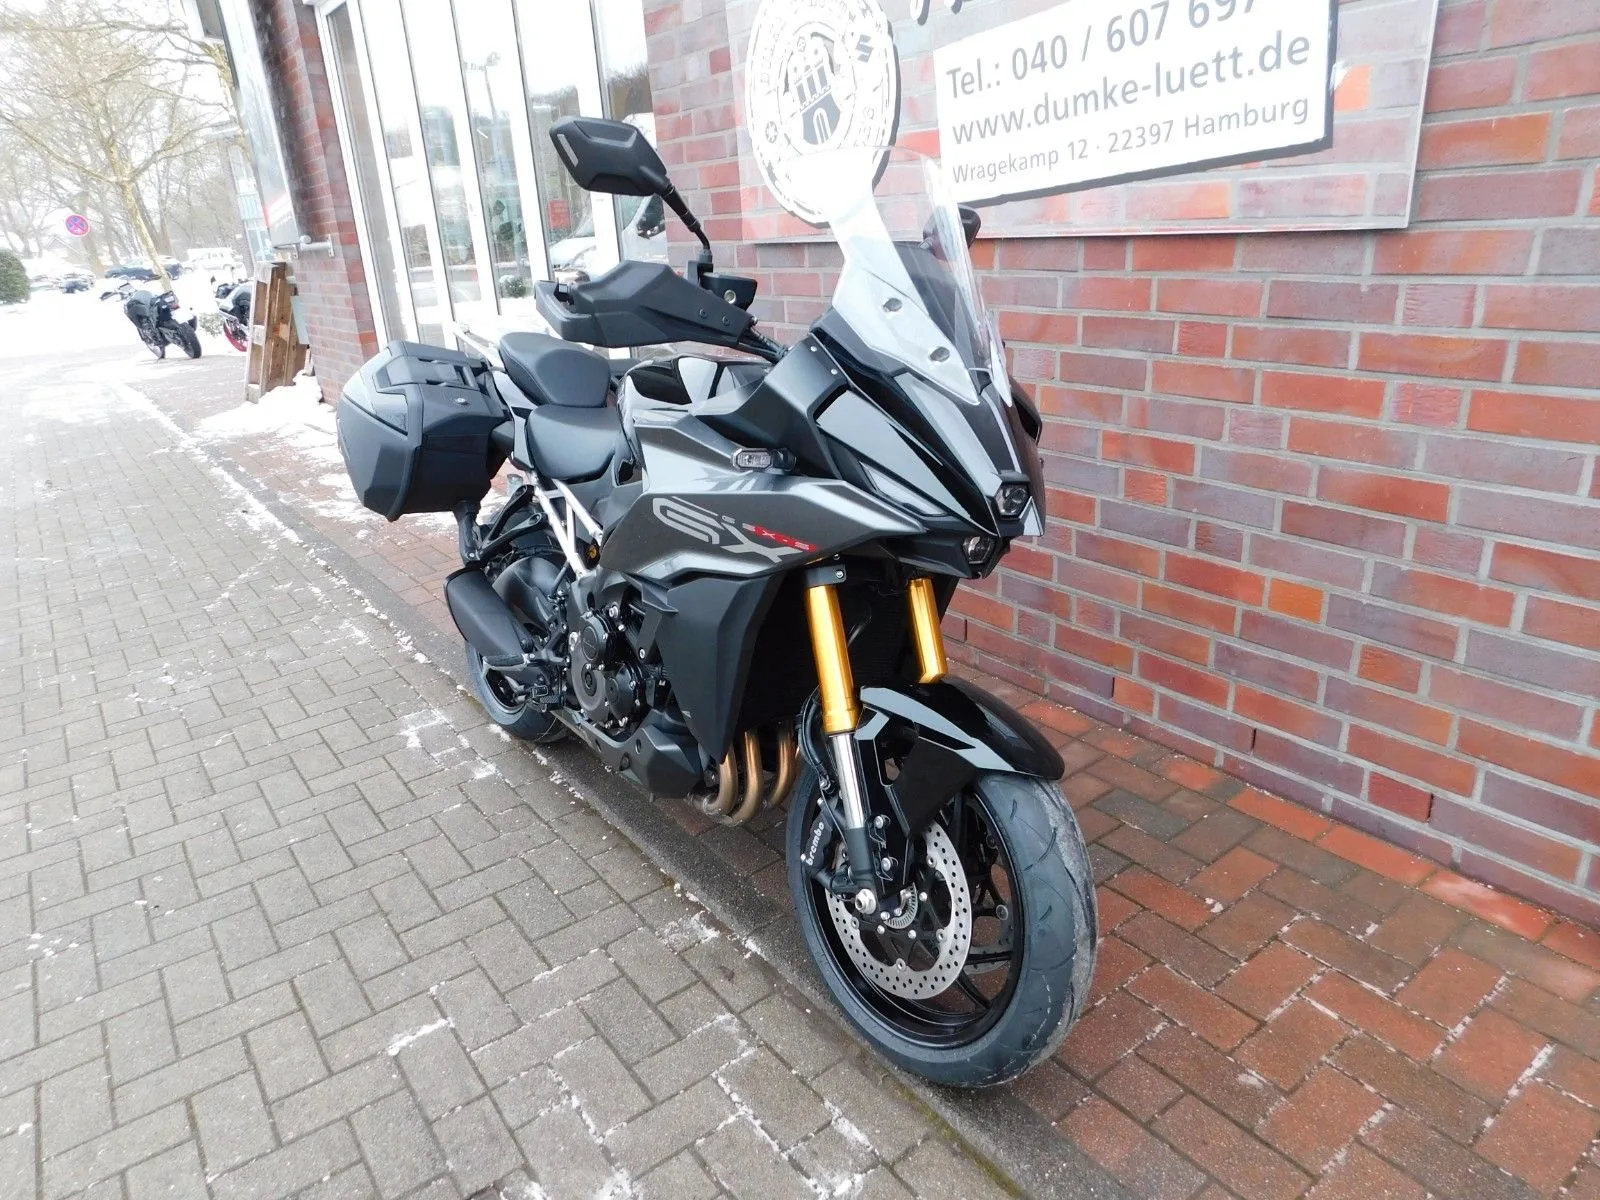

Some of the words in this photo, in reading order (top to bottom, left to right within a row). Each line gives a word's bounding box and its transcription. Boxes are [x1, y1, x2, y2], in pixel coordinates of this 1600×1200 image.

[946, 60, 1000, 99] Tel.:
[1012, 35, 1068, 82] 040
[1106, 0, 1171, 54] 607
[952, 30, 1311, 146] www.dumke-luett.de
[953, 145, 1060, 184] Wragekamp
[1068, 139, 1089, 161] 12
[1108, 120, 1174, 154] 22397
[1184, 96, 1309, 139] Hamburg
[805, 821, 825, 866] brembo
